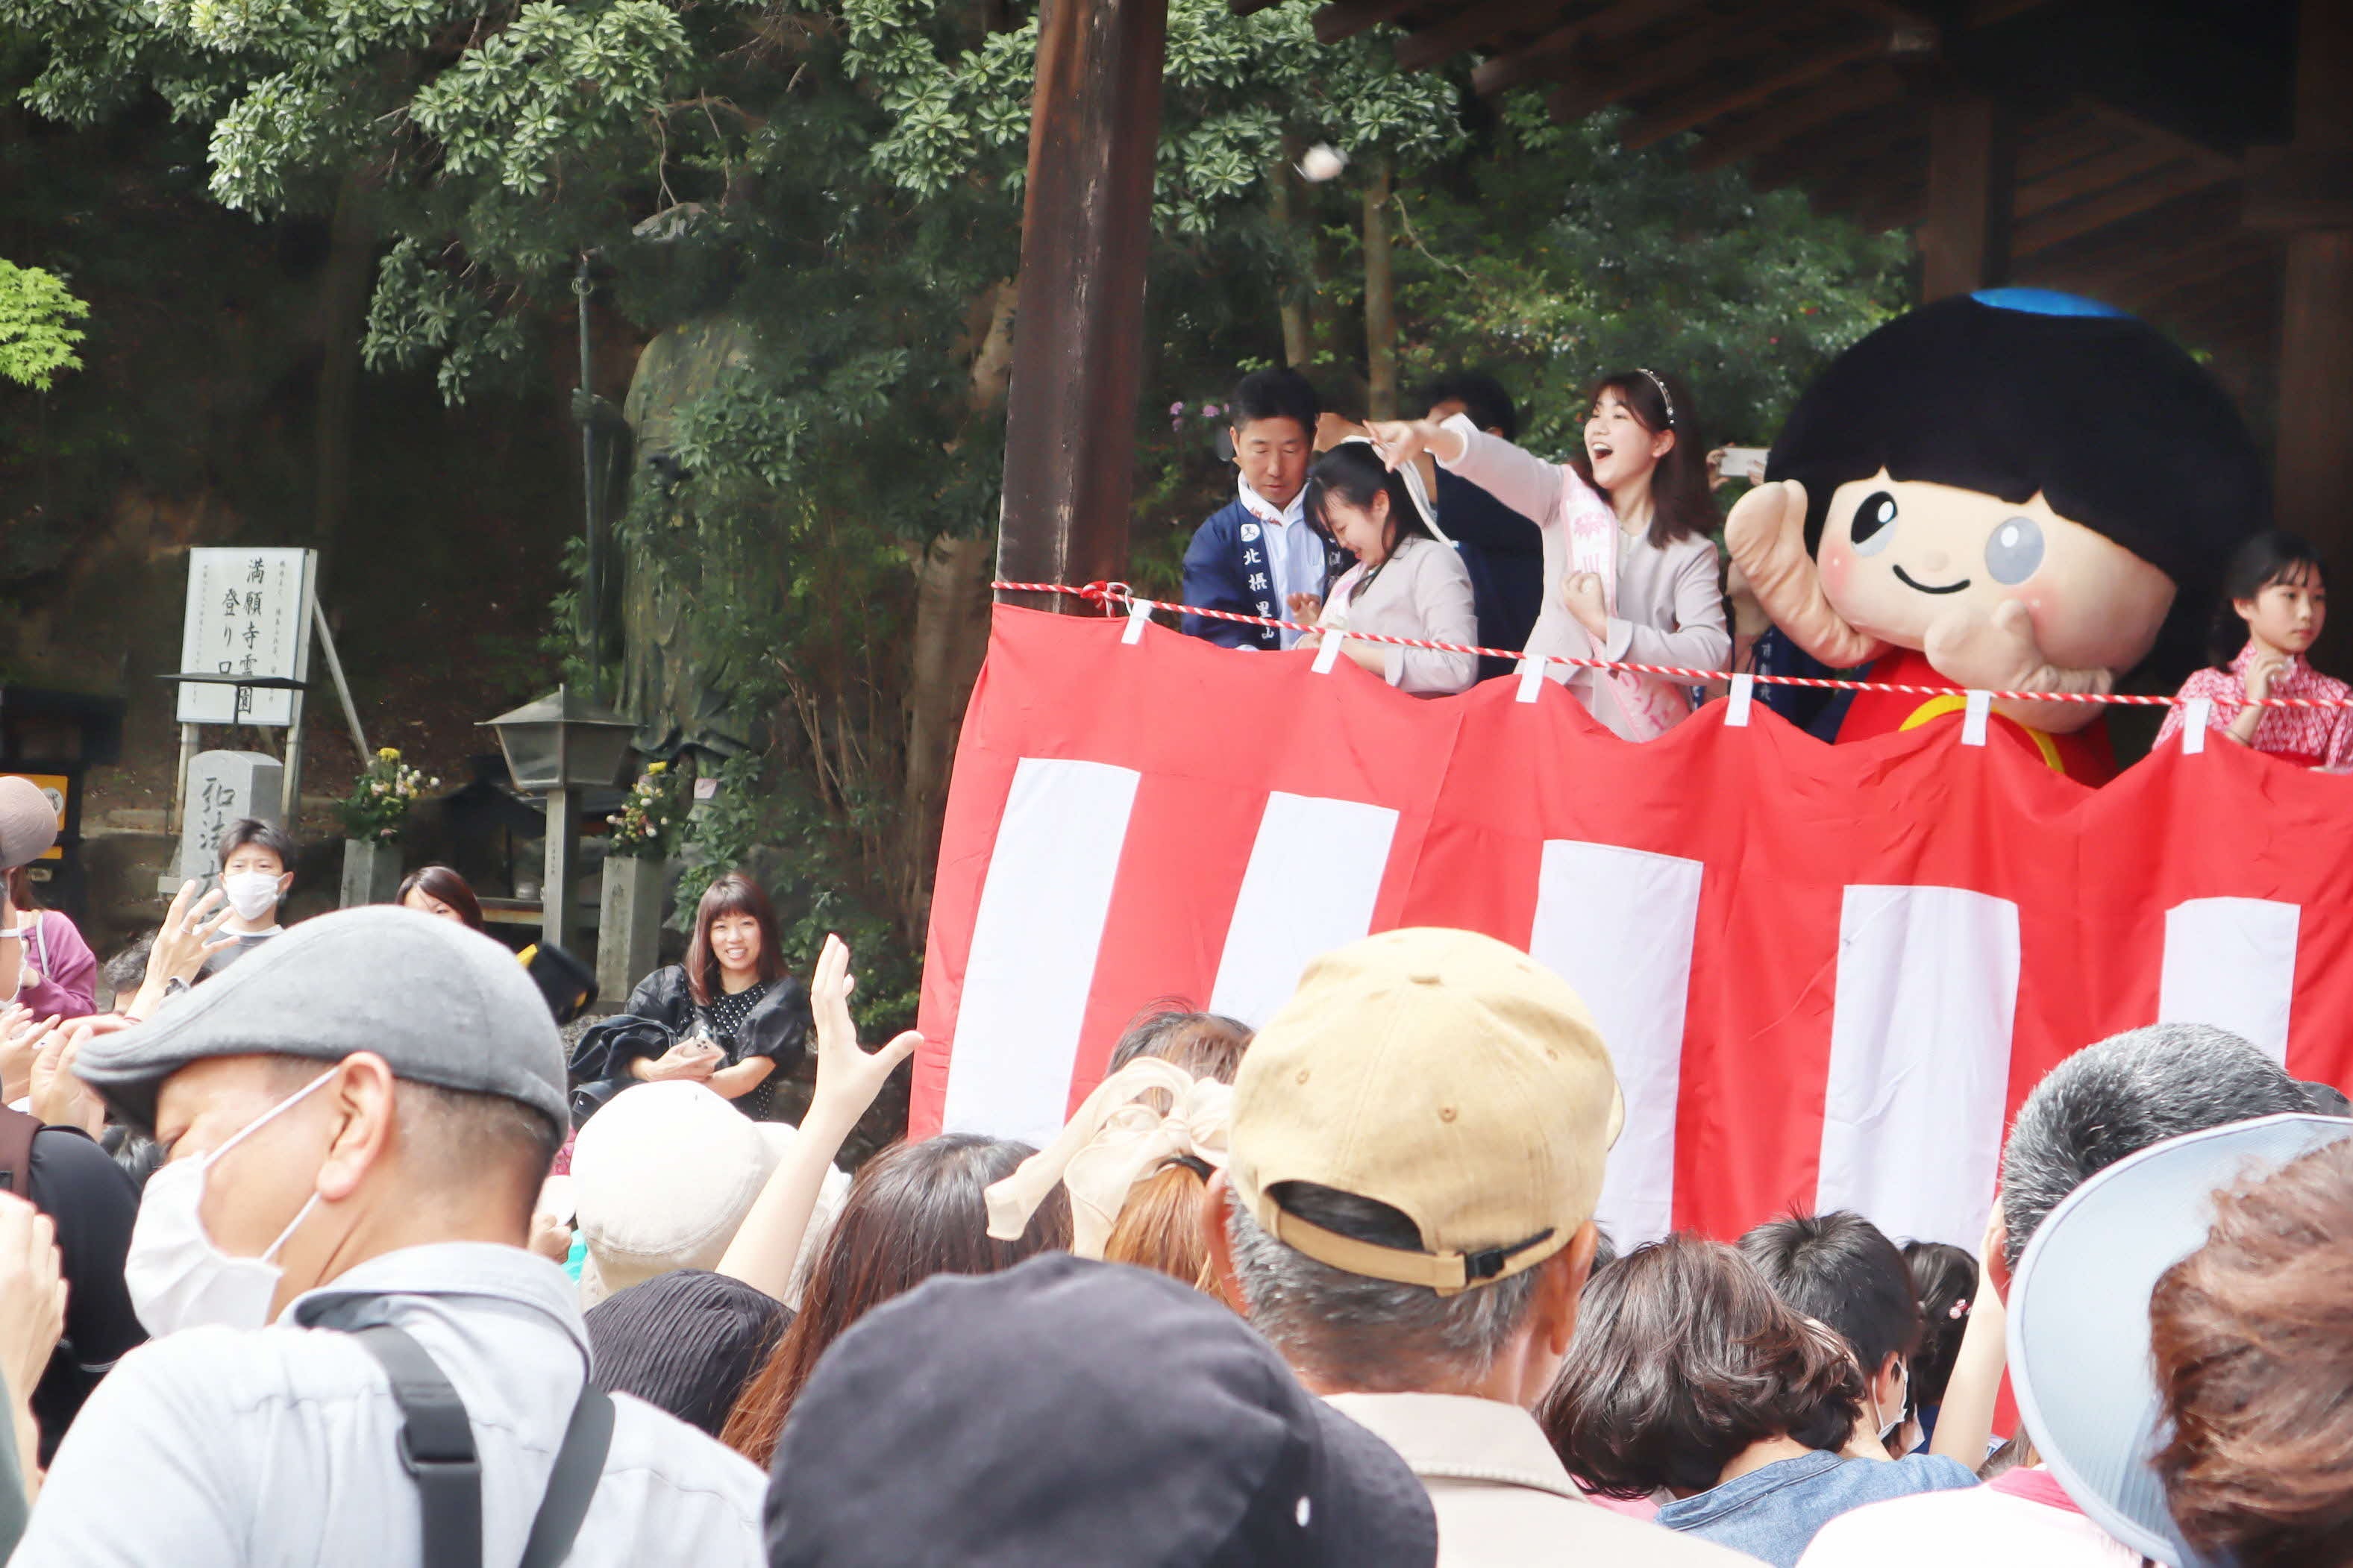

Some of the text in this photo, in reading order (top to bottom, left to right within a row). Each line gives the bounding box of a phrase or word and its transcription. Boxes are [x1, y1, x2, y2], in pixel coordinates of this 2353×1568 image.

[217, 588, 240, 674] 登り口
[1243, 548, 1274, 640] 北摂里山
